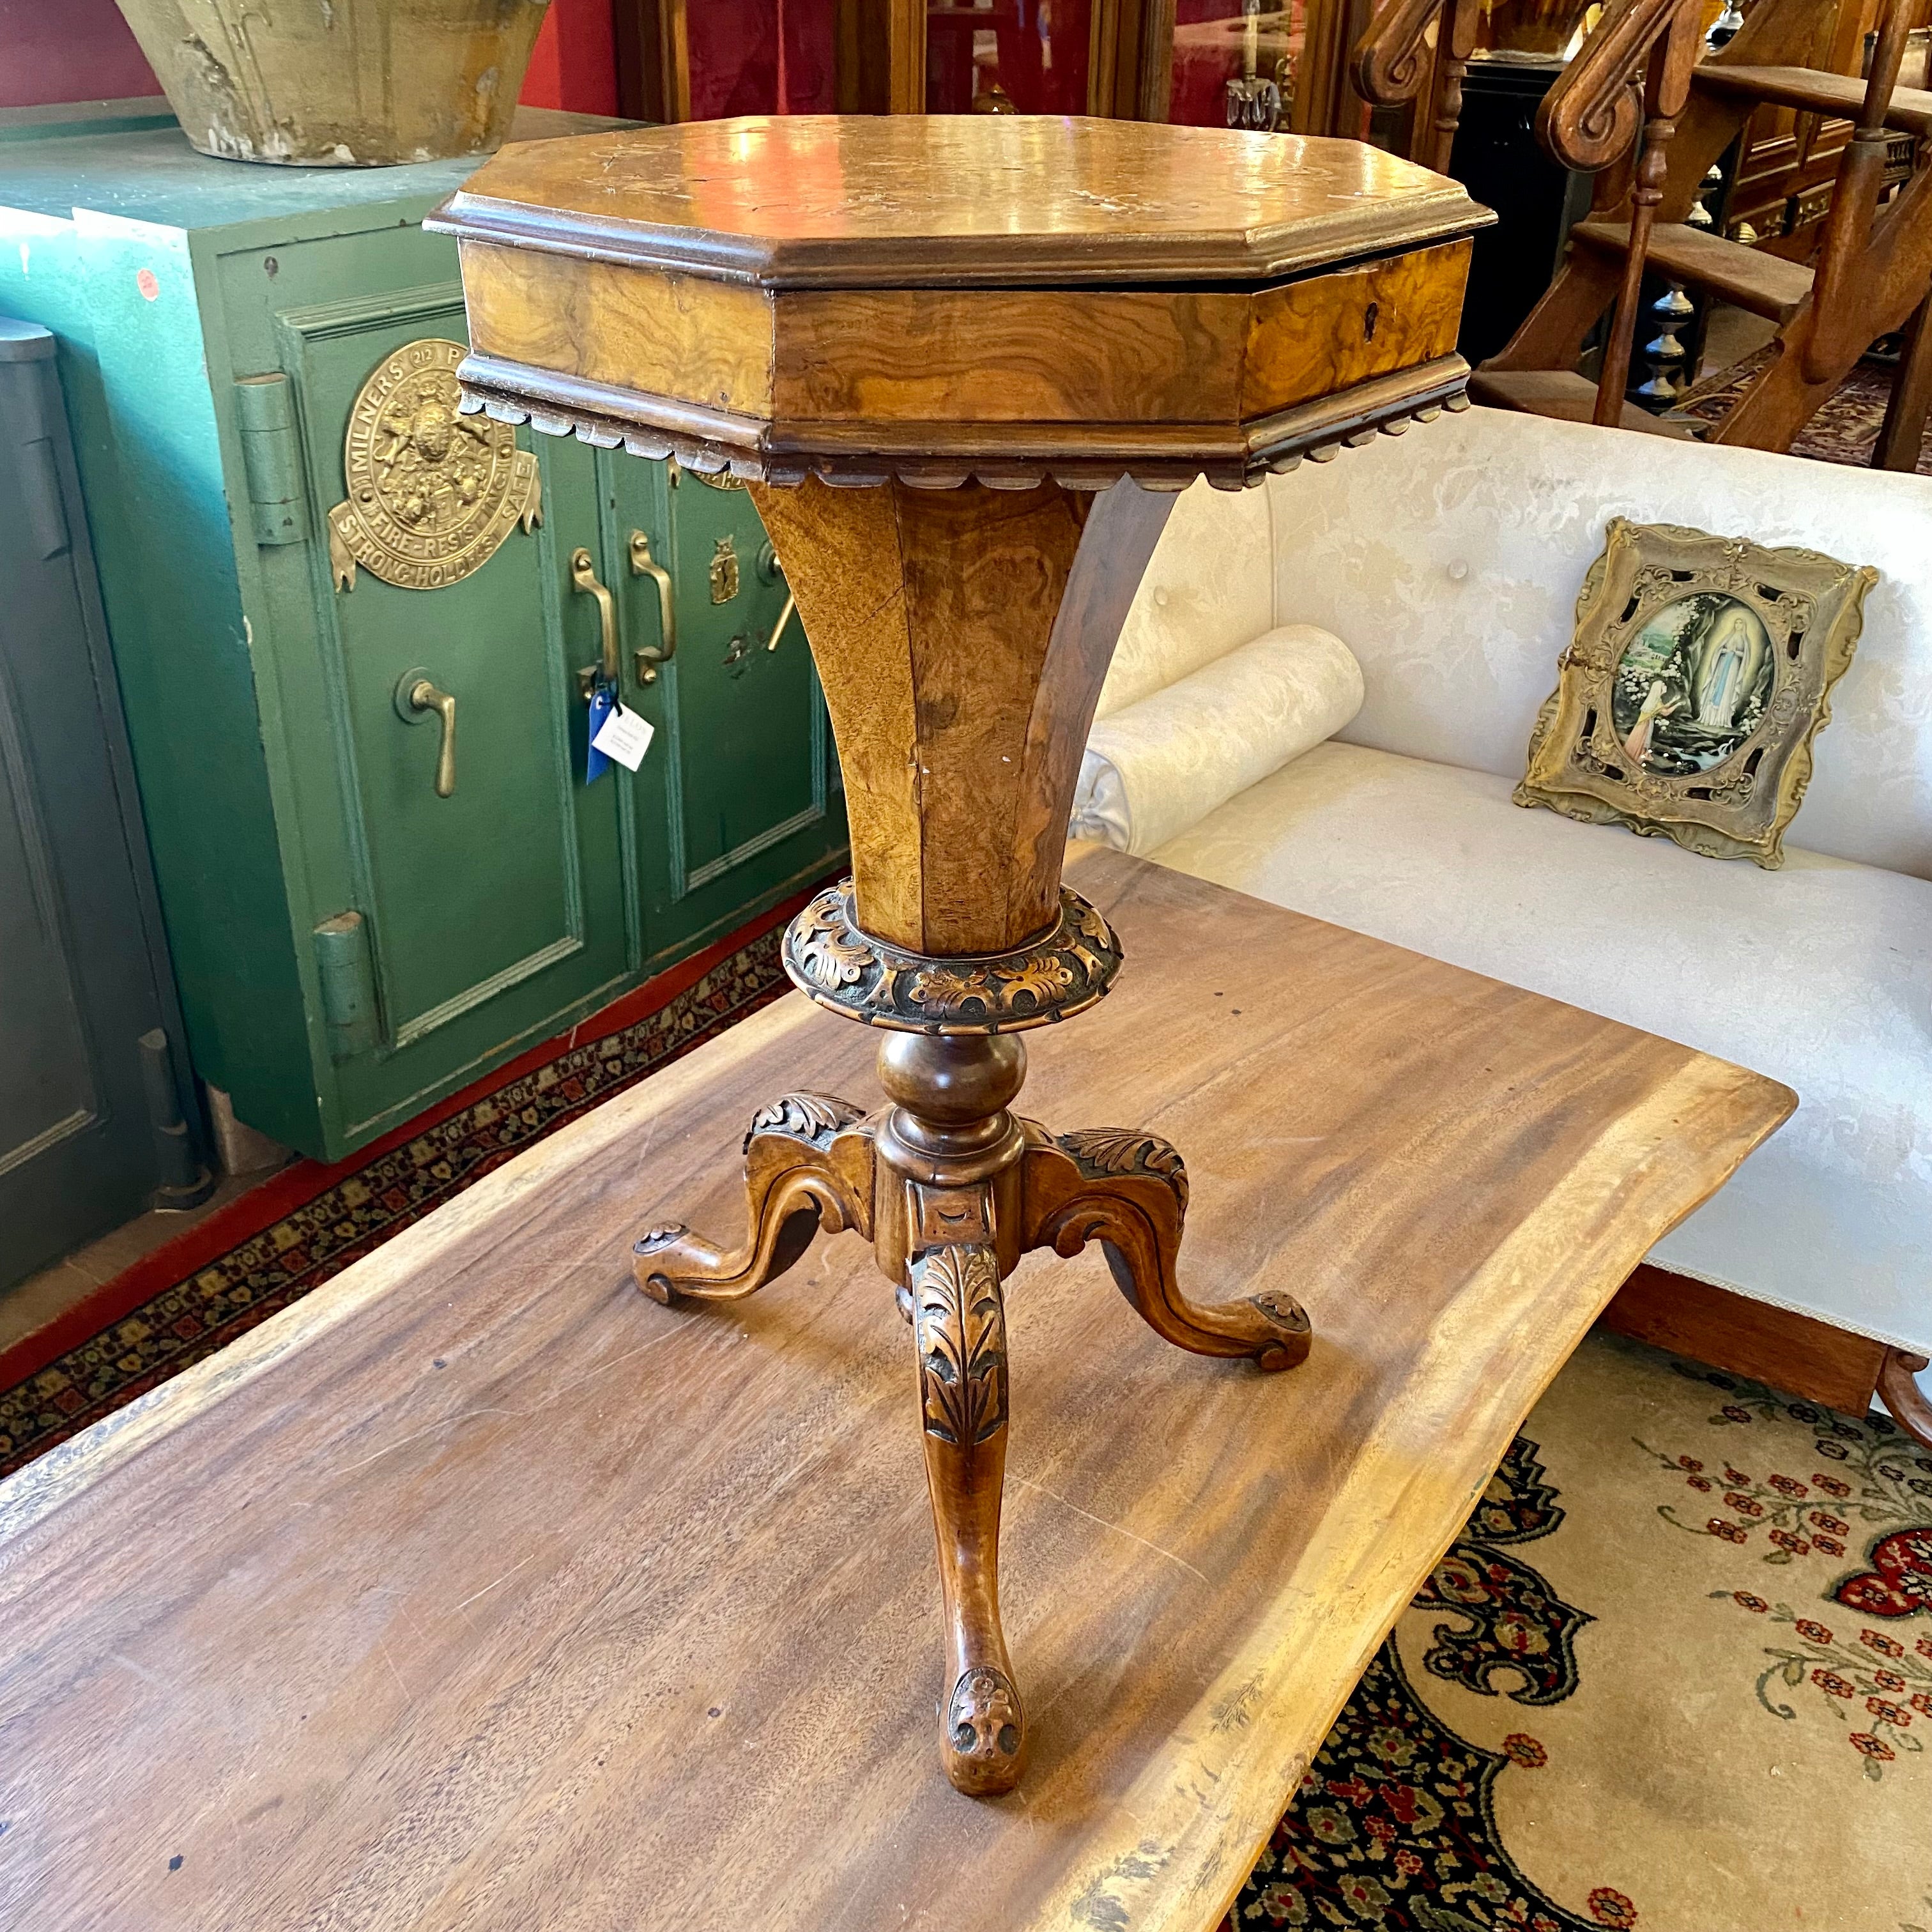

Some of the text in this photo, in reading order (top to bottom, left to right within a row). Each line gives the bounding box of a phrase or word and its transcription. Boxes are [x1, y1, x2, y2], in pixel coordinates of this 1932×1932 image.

[413, 348, 432, 364] 212
[339, 515, 410, 582] STRONG
[503, 462, 531, 521] SAFE
